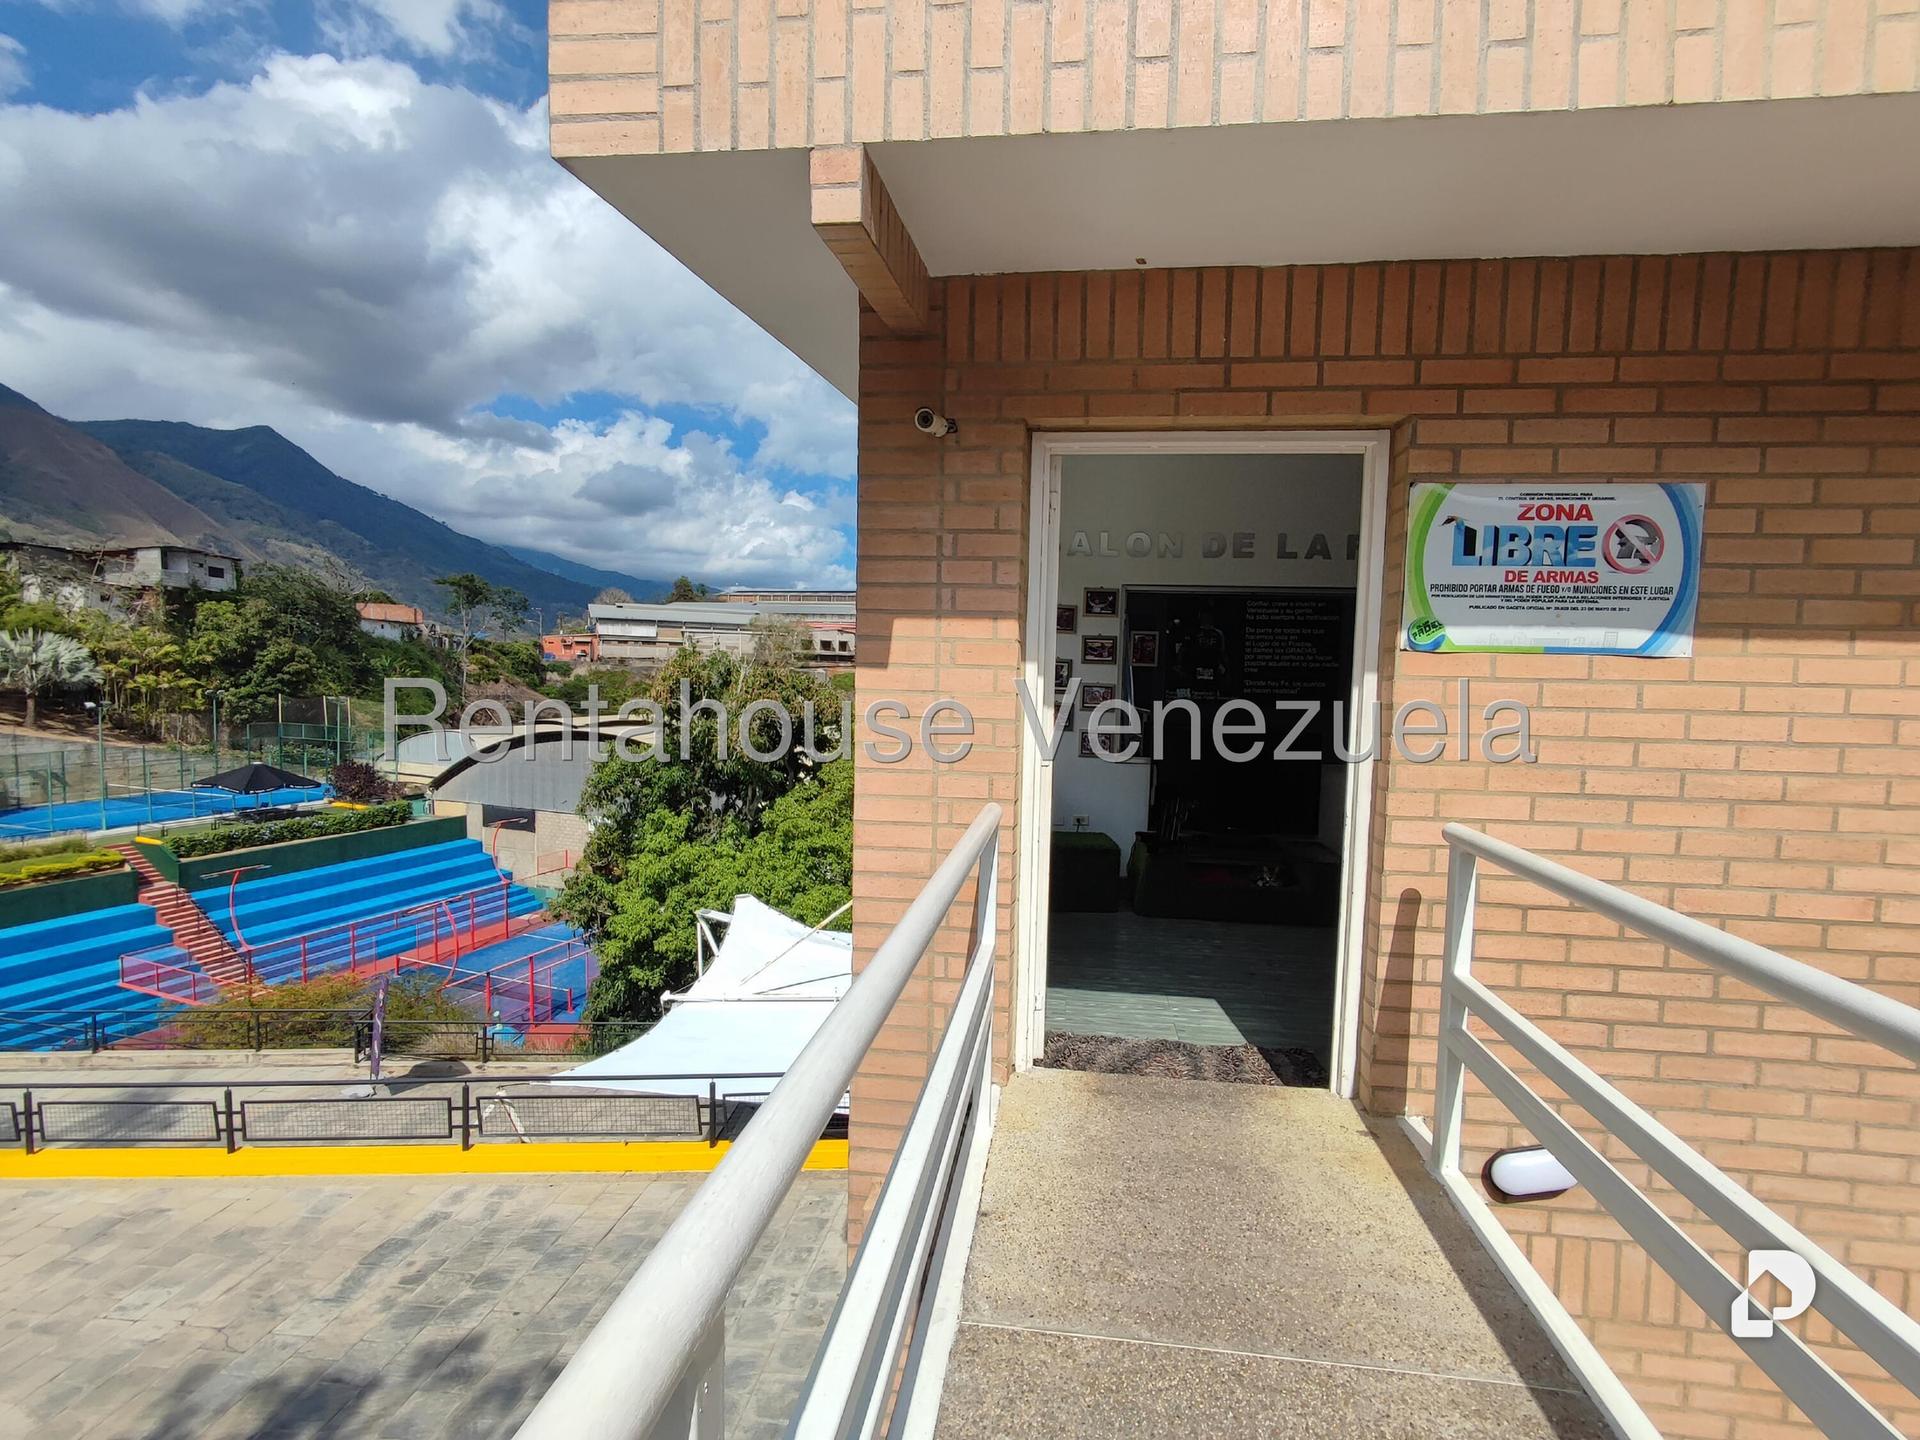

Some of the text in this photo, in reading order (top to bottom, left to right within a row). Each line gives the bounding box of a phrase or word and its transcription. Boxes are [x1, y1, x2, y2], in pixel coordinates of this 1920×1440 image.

[1517, 503, 1593, 521] ZONA
[1059, 530, 1183, 558] ALON
[1201, 532, 1256, 559] DE
[1276, 533, 1332, 560] LA
[1452, 525, 1598, 567] LIBRE
[1504, 570, 1599, 584] DE ARMAS
[1430, 583, 1468, 593] PROHIBIDO
[1469, 584, 1497, 593] PORTAR
[1498, 584, 1524, 593] ARMAS
[1525, 584, 1535, 593] DE
[1536, 585, 1560, 594] FUEGO
[1572, 585, 1617, 595] MUNICIONES
[1619, 586, 1629, 595] EN
[1630, 586, 1648, 595] ESTE
[1649, 586, 1673, 595] LUGAR
